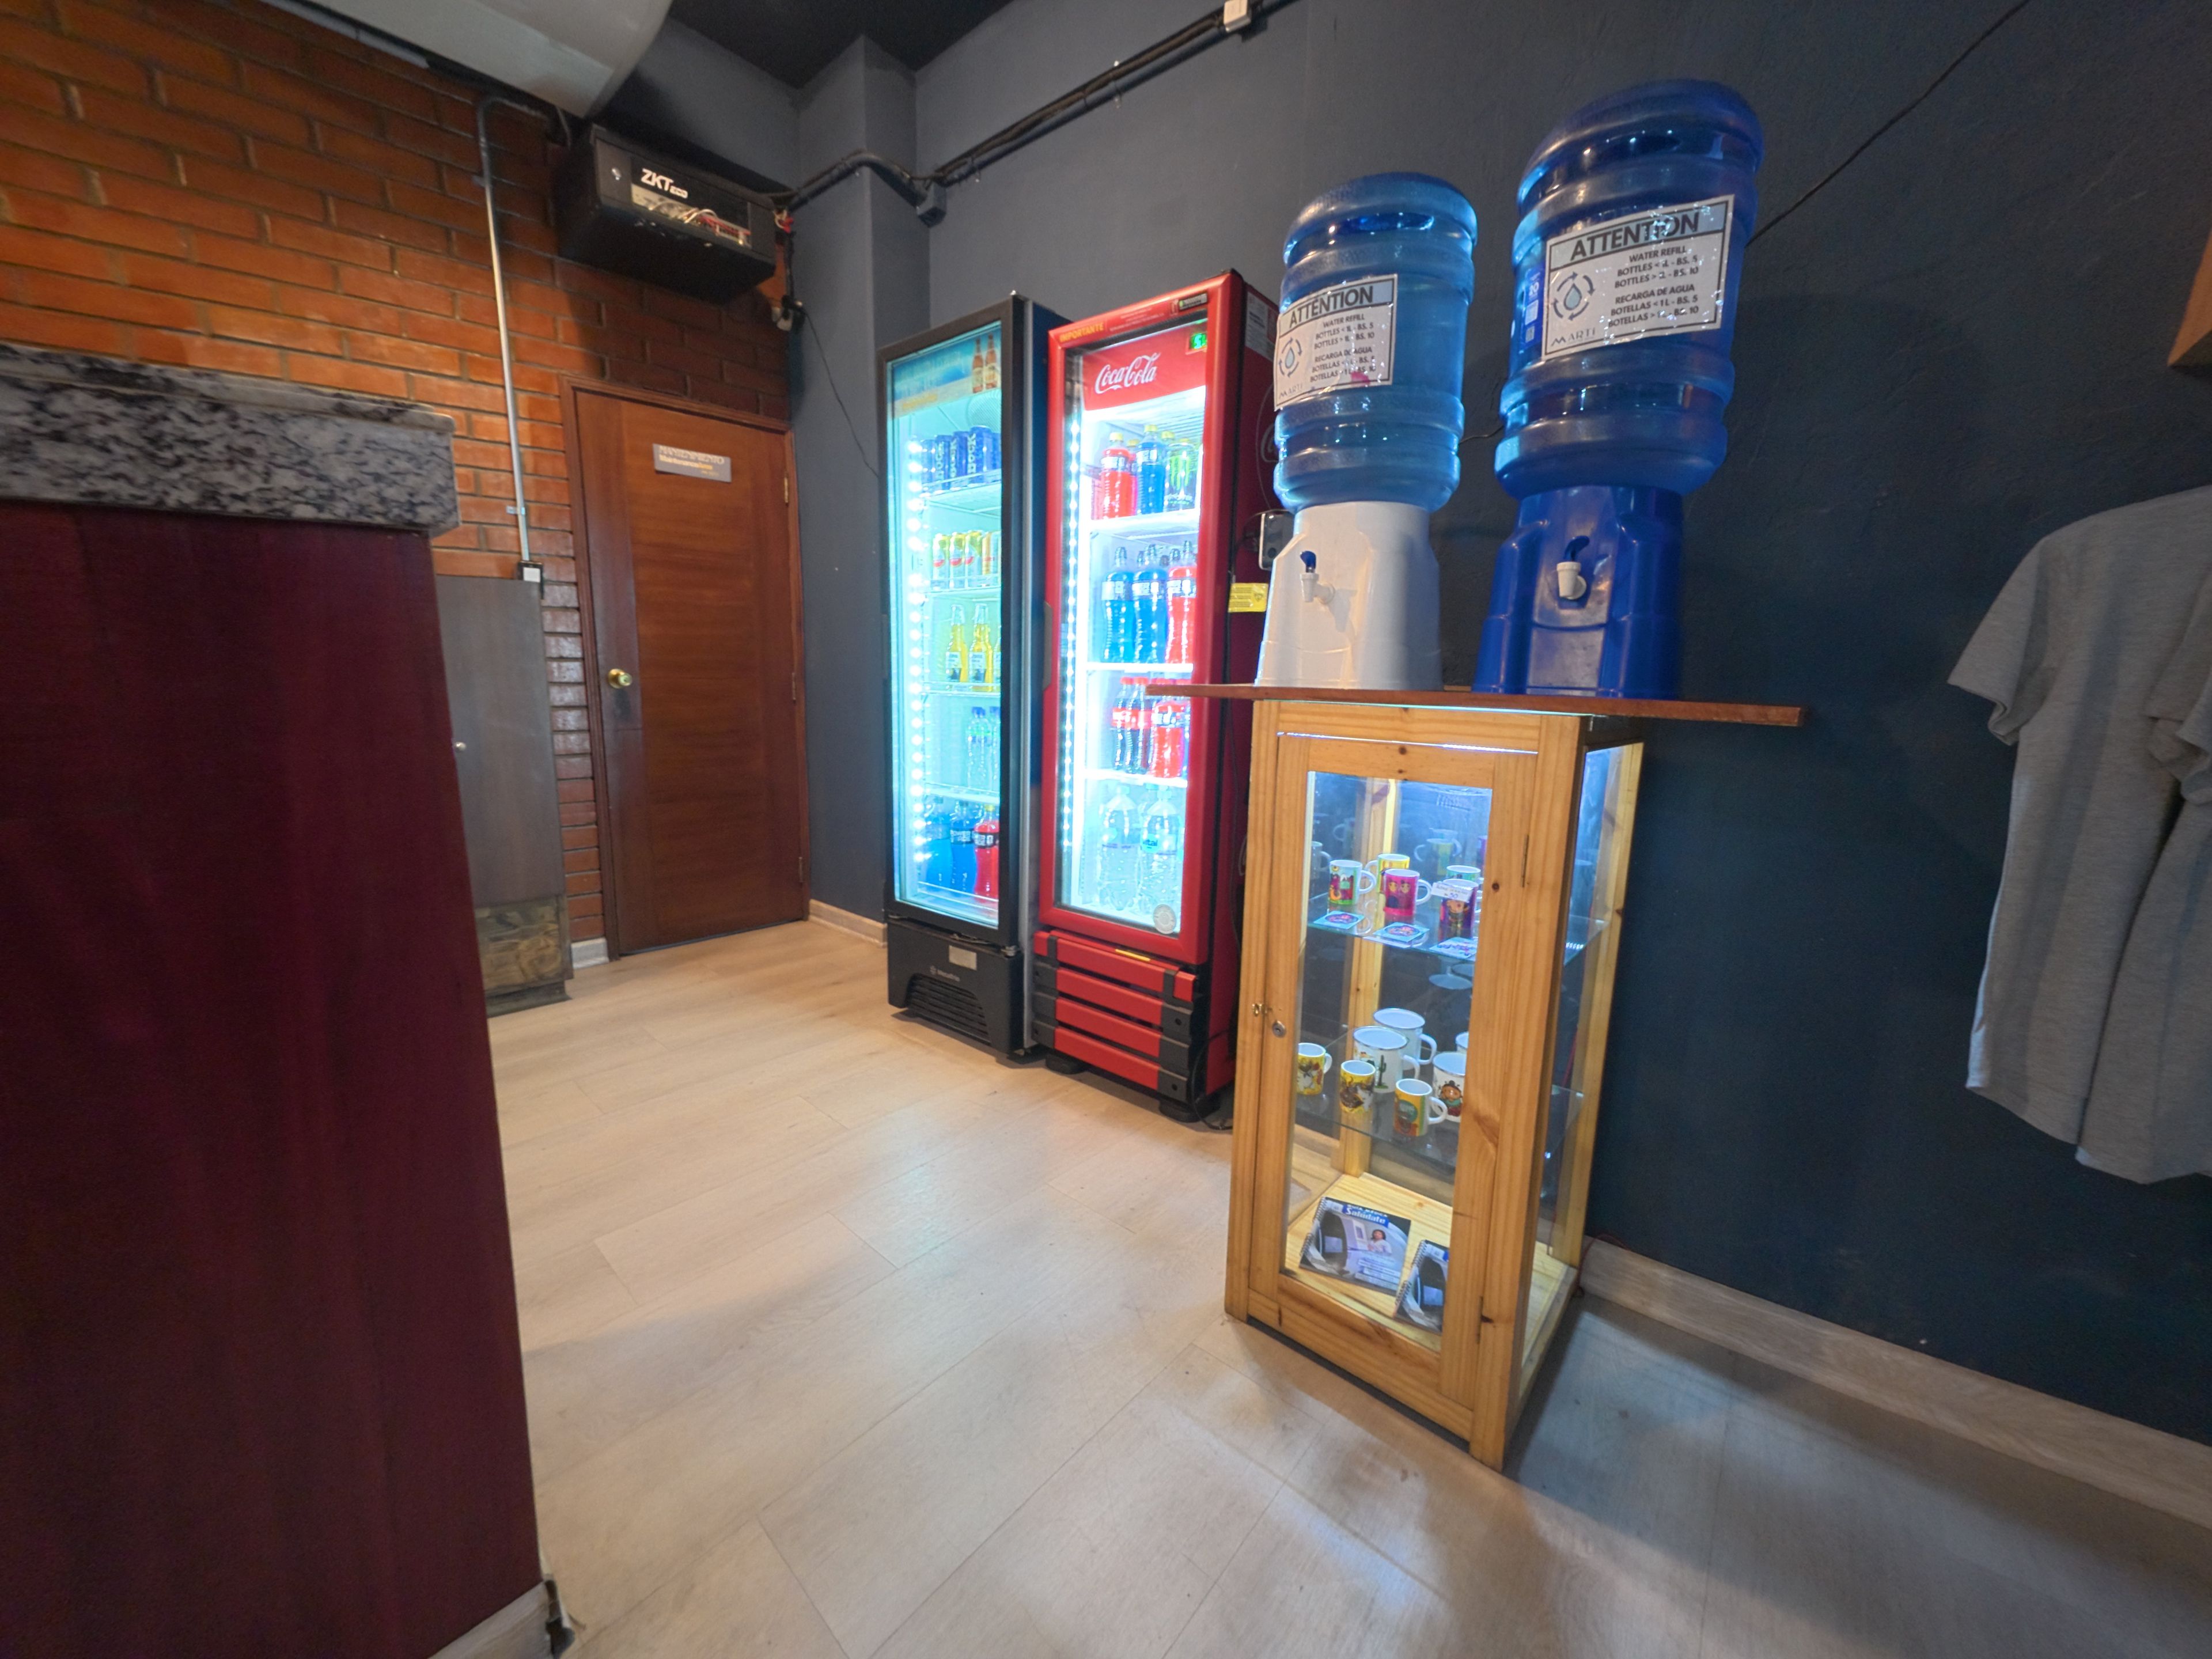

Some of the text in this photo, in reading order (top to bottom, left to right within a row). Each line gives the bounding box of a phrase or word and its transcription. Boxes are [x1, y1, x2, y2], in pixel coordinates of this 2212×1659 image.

[1571, 212, 1699, 261] ATTENTION
[1629, 245, 1687, 263] WATER REFILL
[1618, 263, 1653, 276] BOTTLES
[1676, 257, 1690, 265] BS.
[1615, 274, 1650, 288] BOTTLES
[1673, 268, 1686, 277] BS.
[1615, 284, 1695, 304] RECARGA DE AGUA
[1289, 286, 1374, 328] ATTENTION
[1611, 301, 1651, 316] BOTELLAS
[1677, 296, 1690, 304] BS.
[1692, 294, 1698, 302] 5
[1323, 313, 1365, 328] WATER REFILL
[1608, 312, 1648, 327] BOTELLAS
[1690, 306, 1699, 314] 10
[1059, 323, 1104, 343] IMPORTANTE
[1316, 327, 1340, 340] BOTTLES
[1314, 338, 1338, 350] BOTTLES
[1315, 351, 1342, 362] RECARGA
[1095, 353, 1161, 394] Coca-Cola
[1310, 370, 1338, 382] BOTELLAS
[1312, 361, 1340, 373] BOTELLAS
